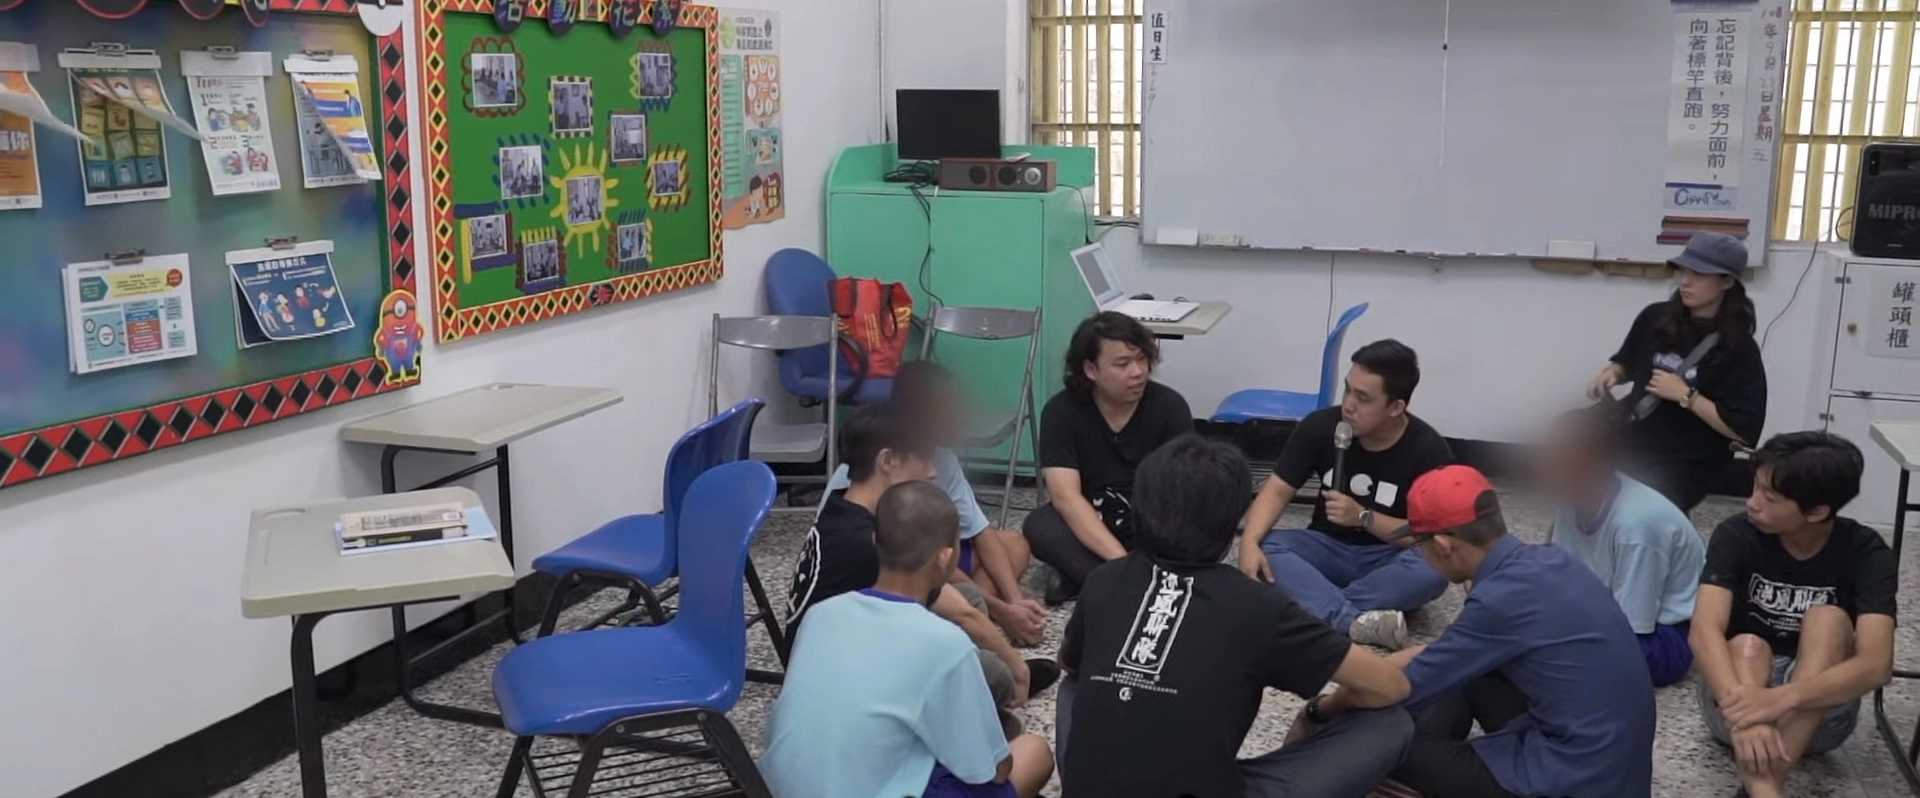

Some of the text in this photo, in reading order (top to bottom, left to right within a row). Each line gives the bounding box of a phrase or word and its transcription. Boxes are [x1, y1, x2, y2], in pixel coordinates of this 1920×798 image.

[1150, 12, 1165, 61] 值日生
[1683, 18, 1709, 131] 向著標竿直跑。
[1868, 203, 1920, 220] MIPR
[1886, 281, 1916, 348] 罐頭櫃
